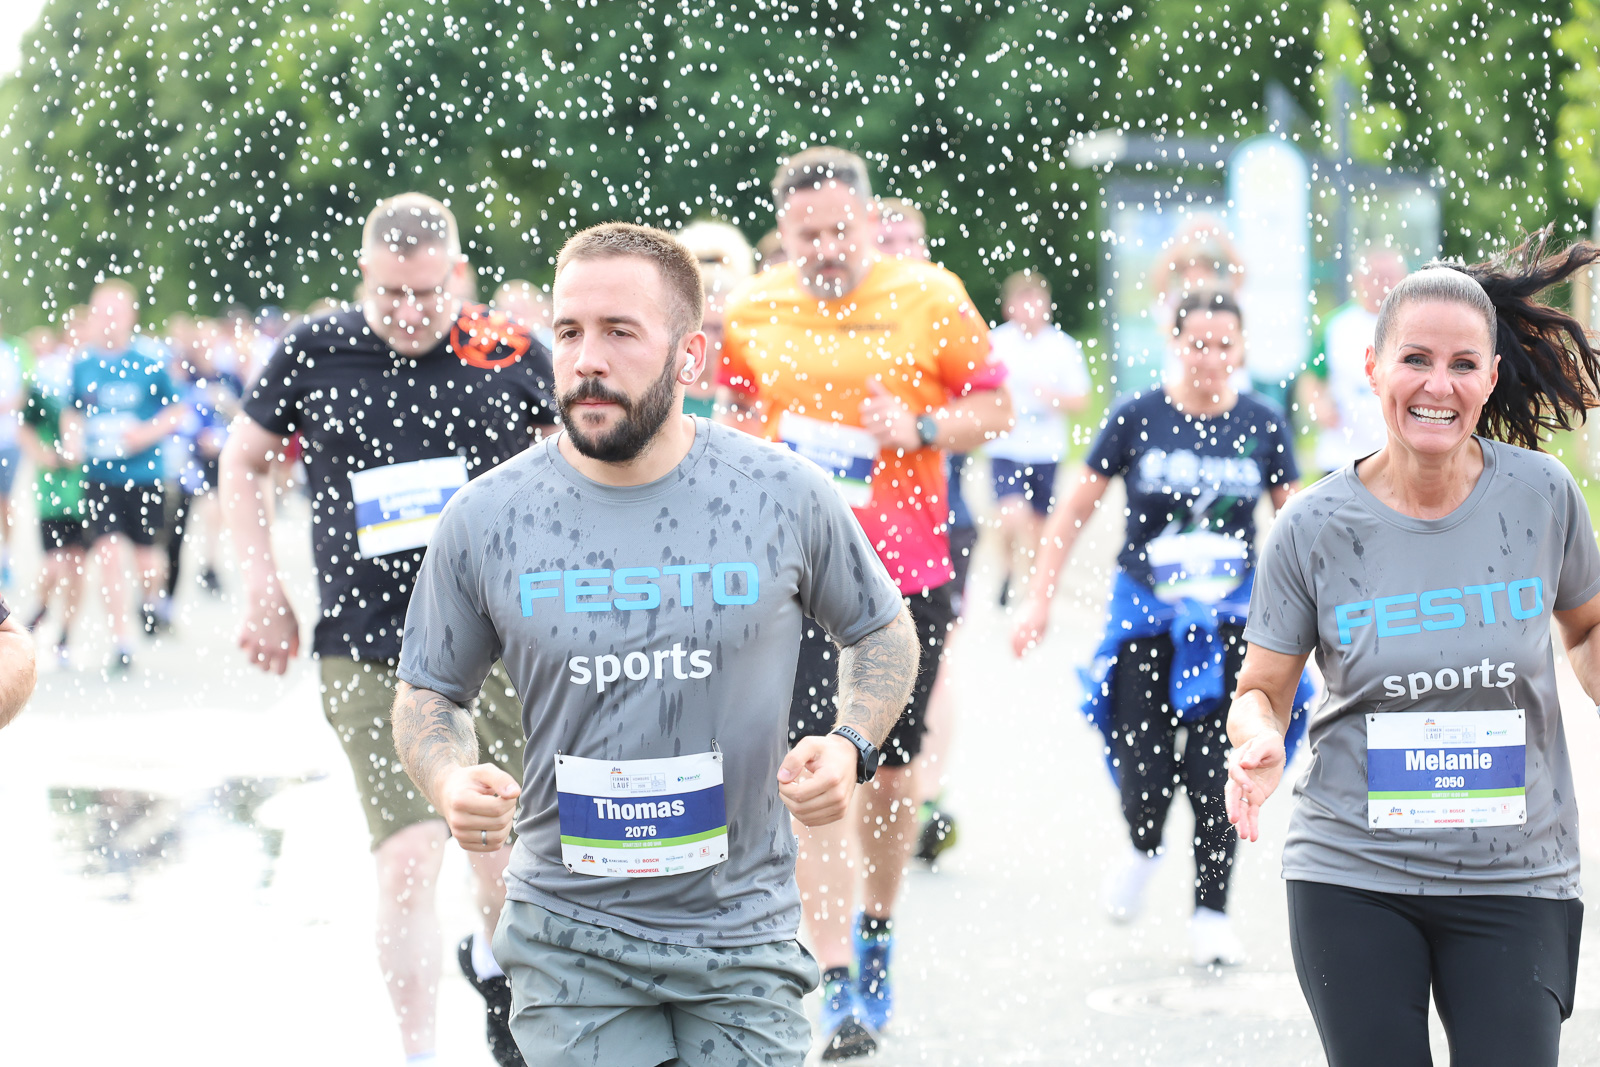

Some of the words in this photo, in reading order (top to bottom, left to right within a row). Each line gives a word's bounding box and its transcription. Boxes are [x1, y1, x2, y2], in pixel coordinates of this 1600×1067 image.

[519, 562, 759, 617] FESTO
[1334, 576, 1543, 645] FESTO
[568, 642, 713, 693] sports
[1383, 657, 1516, 700] sports
[1405, 749, 1492, 771] Melanie
[1434, 776, 1465, 788] 2050
[593, 798, 685, 820] Thomas
[625, 825, 657, 838] 2076
